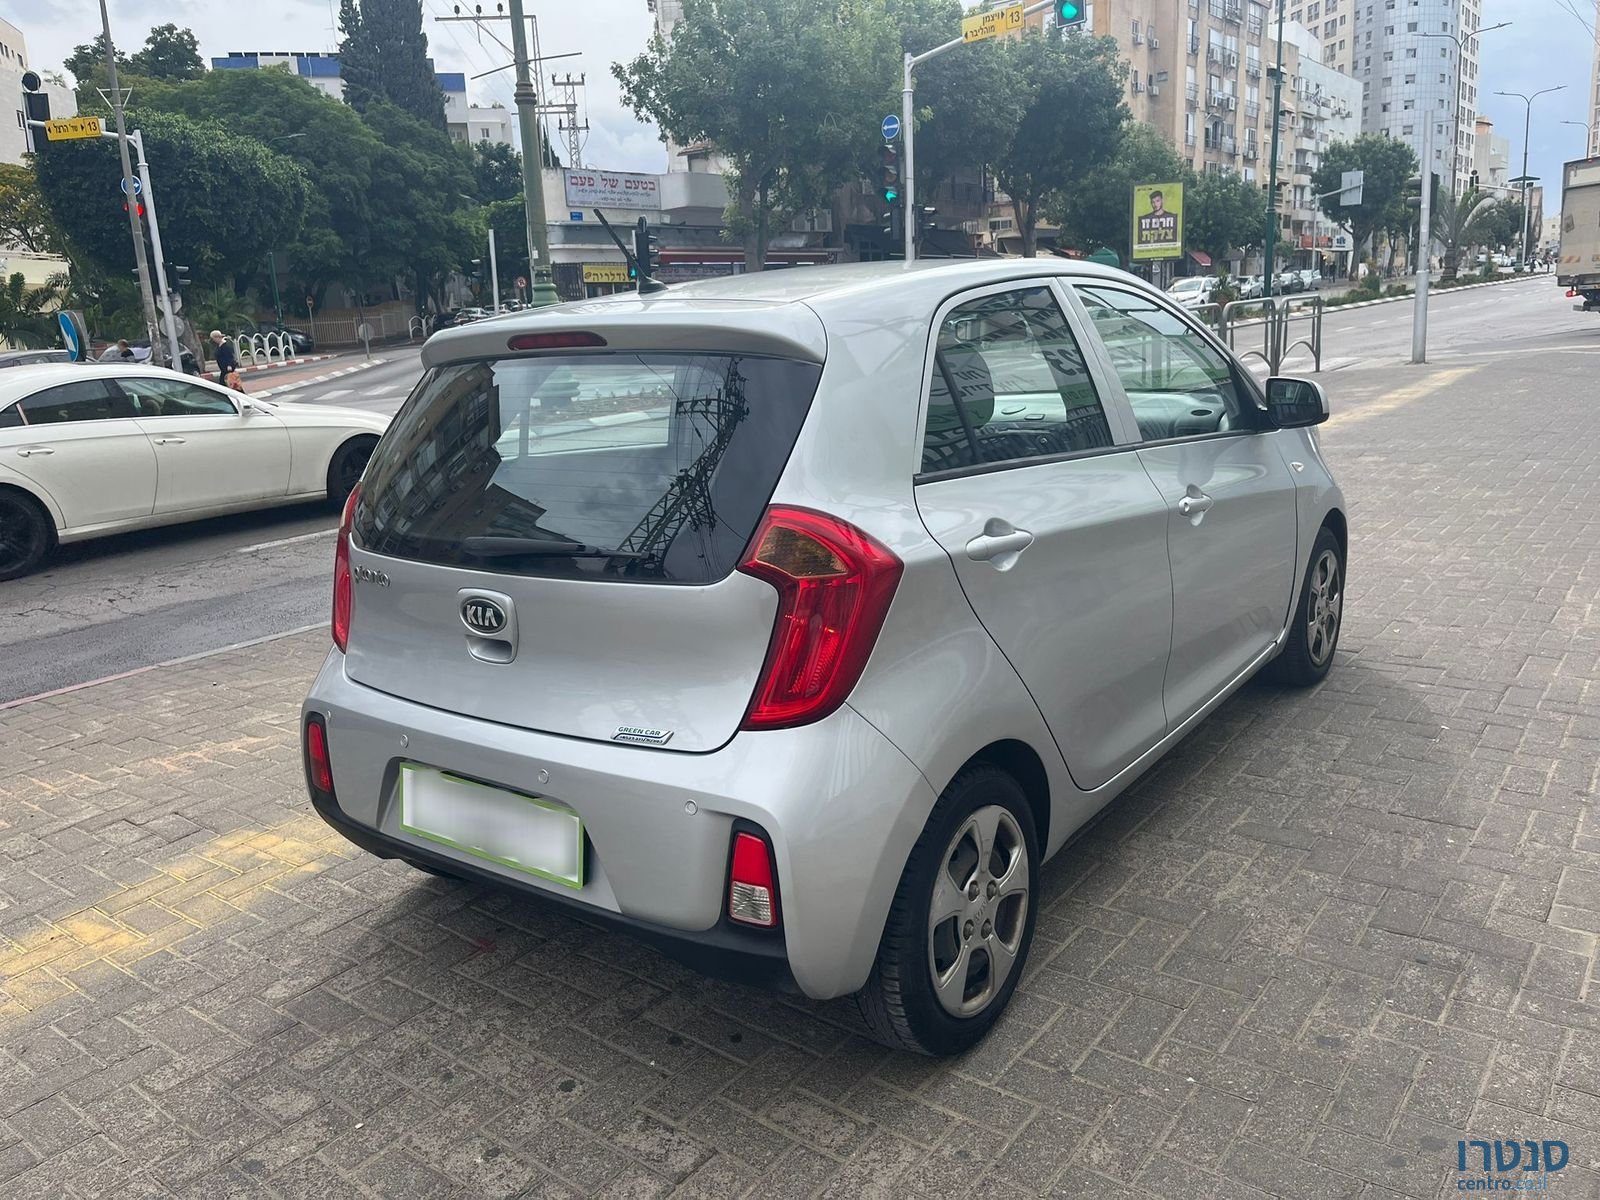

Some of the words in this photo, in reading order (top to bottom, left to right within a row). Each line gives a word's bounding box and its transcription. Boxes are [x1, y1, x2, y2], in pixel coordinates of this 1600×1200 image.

[982, 12, 1000, 26] ויצמן
[1009, 10, 1020, 24] 13
[969, 25, 996, 38] מוהליבר
[53, 122, 69, 134] הרצל
[87, 121, 98, 132] 13
[570, 175, 595, 187] פעם
[600, 174, 619, 188] של
[624, 179, 656, 191] בטעם
[1141, 218, 1151, 229] זו
[1152, 216, 1174, 229] חרם
[1141, 227, 1174, 243] צלקת
[592, 271, 629, 282] נדלריה
[466, 604, 498, 627] KIA
[618, 726, 644, 734] GREEN
